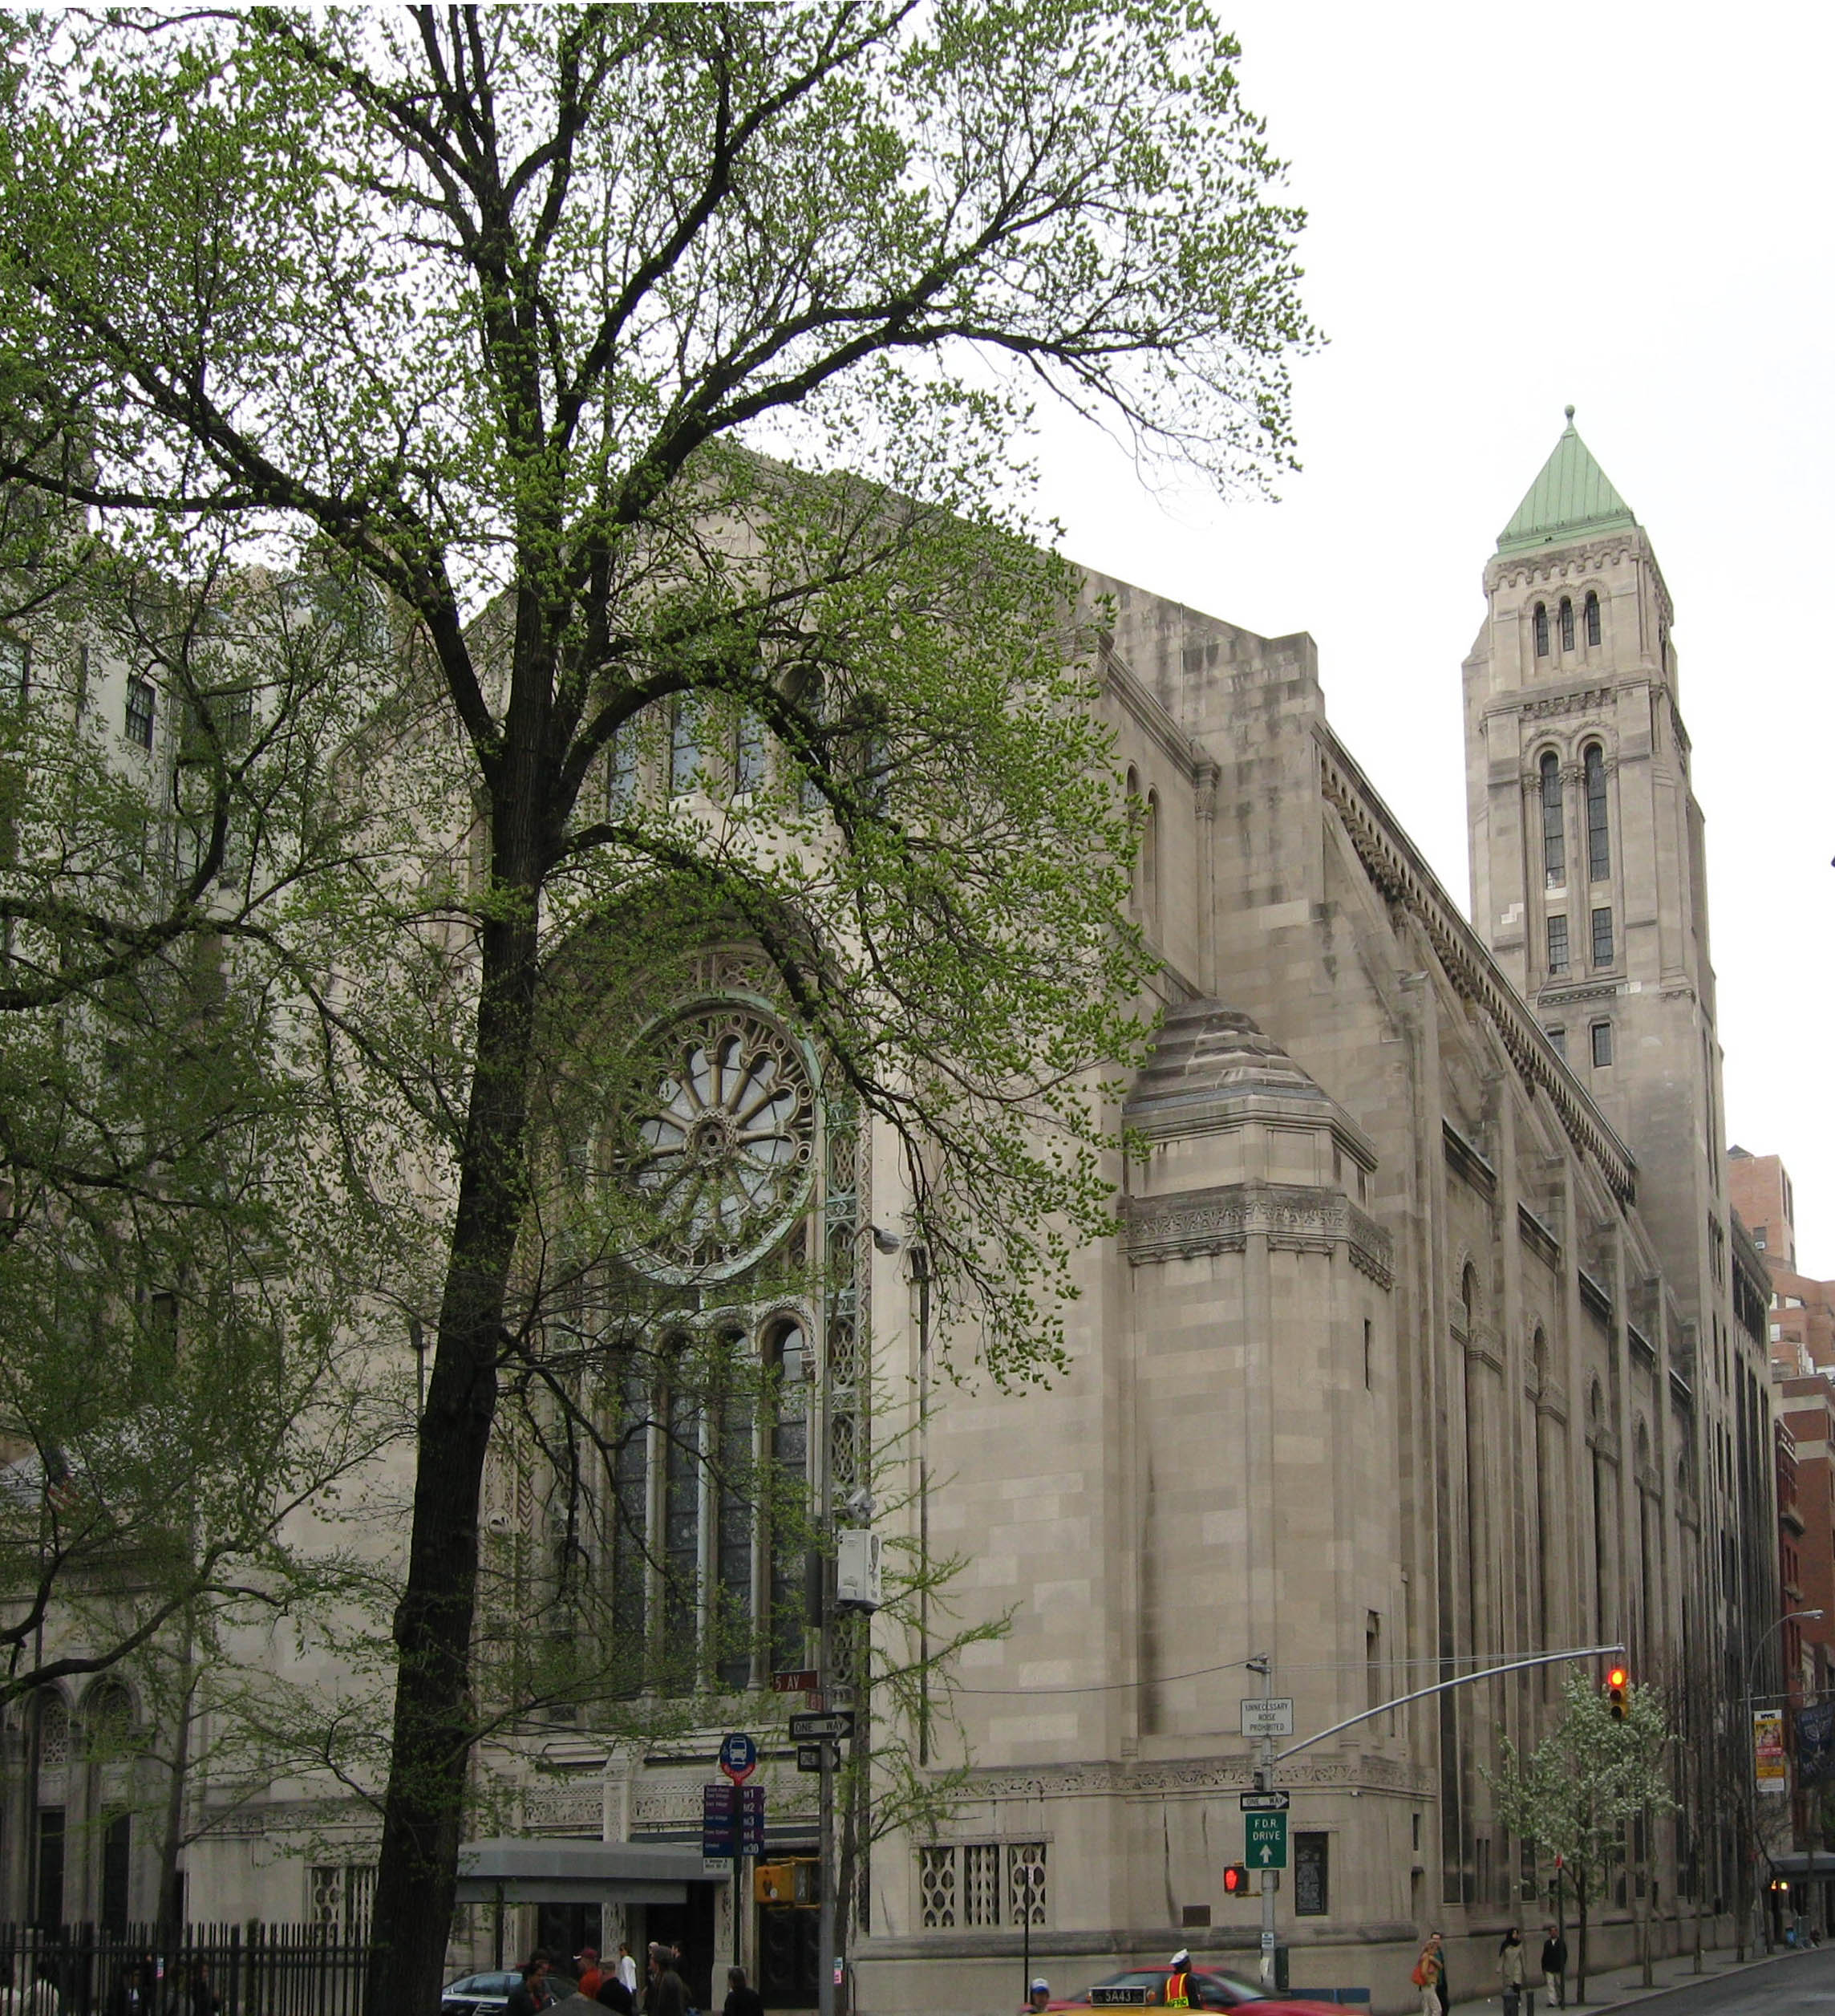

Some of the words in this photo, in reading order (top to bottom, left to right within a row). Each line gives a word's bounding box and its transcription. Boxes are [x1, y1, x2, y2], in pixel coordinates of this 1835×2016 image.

[776, 1676, 781, 1691] 5
[788, 1675, 800, 1689] AV
[1246, 1702, 1288, 1711] UNNECESSARY
[795, 1722, 814, 1734] ONE
[826, 1720, 844, 1731] WAY
[1250, 1722, 1284, 1732] PROHIBITED
[1270, 1795, 1284, 1804] WAY
[1253, 1831, 1281, 1841] DRIVE
